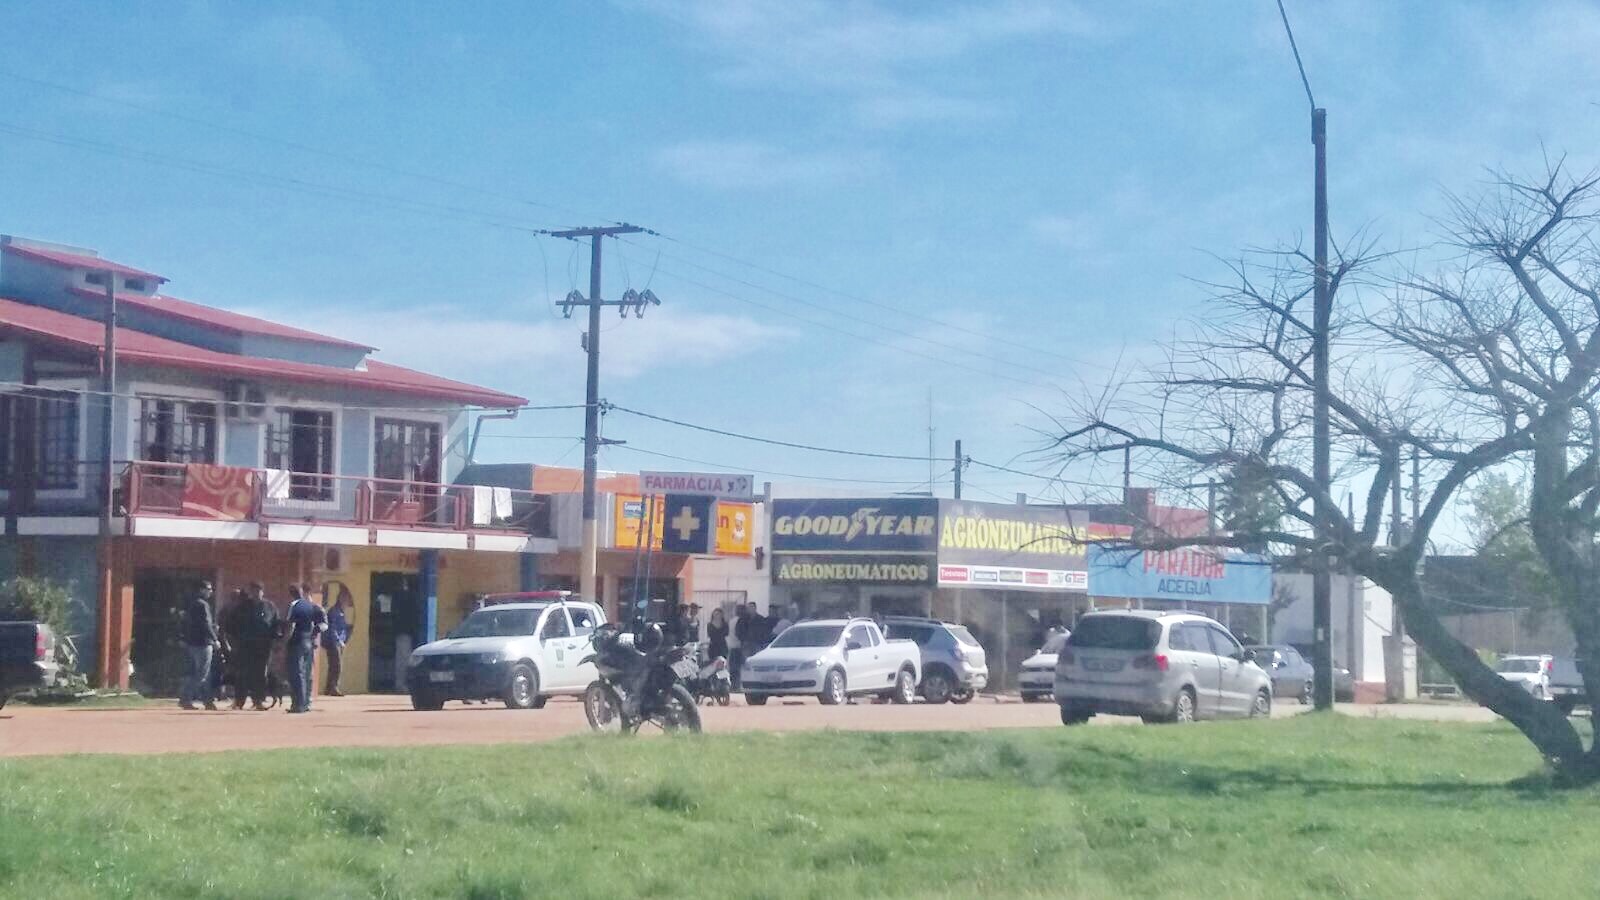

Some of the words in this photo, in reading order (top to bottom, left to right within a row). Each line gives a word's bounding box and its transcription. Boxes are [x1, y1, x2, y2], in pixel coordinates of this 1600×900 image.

[644, 474, 723, 492] FARMÁCIA
[778, 563, 929, 580] AGRONEUMATICOS
[1157, 578, 1212, 595] ACEGUA
